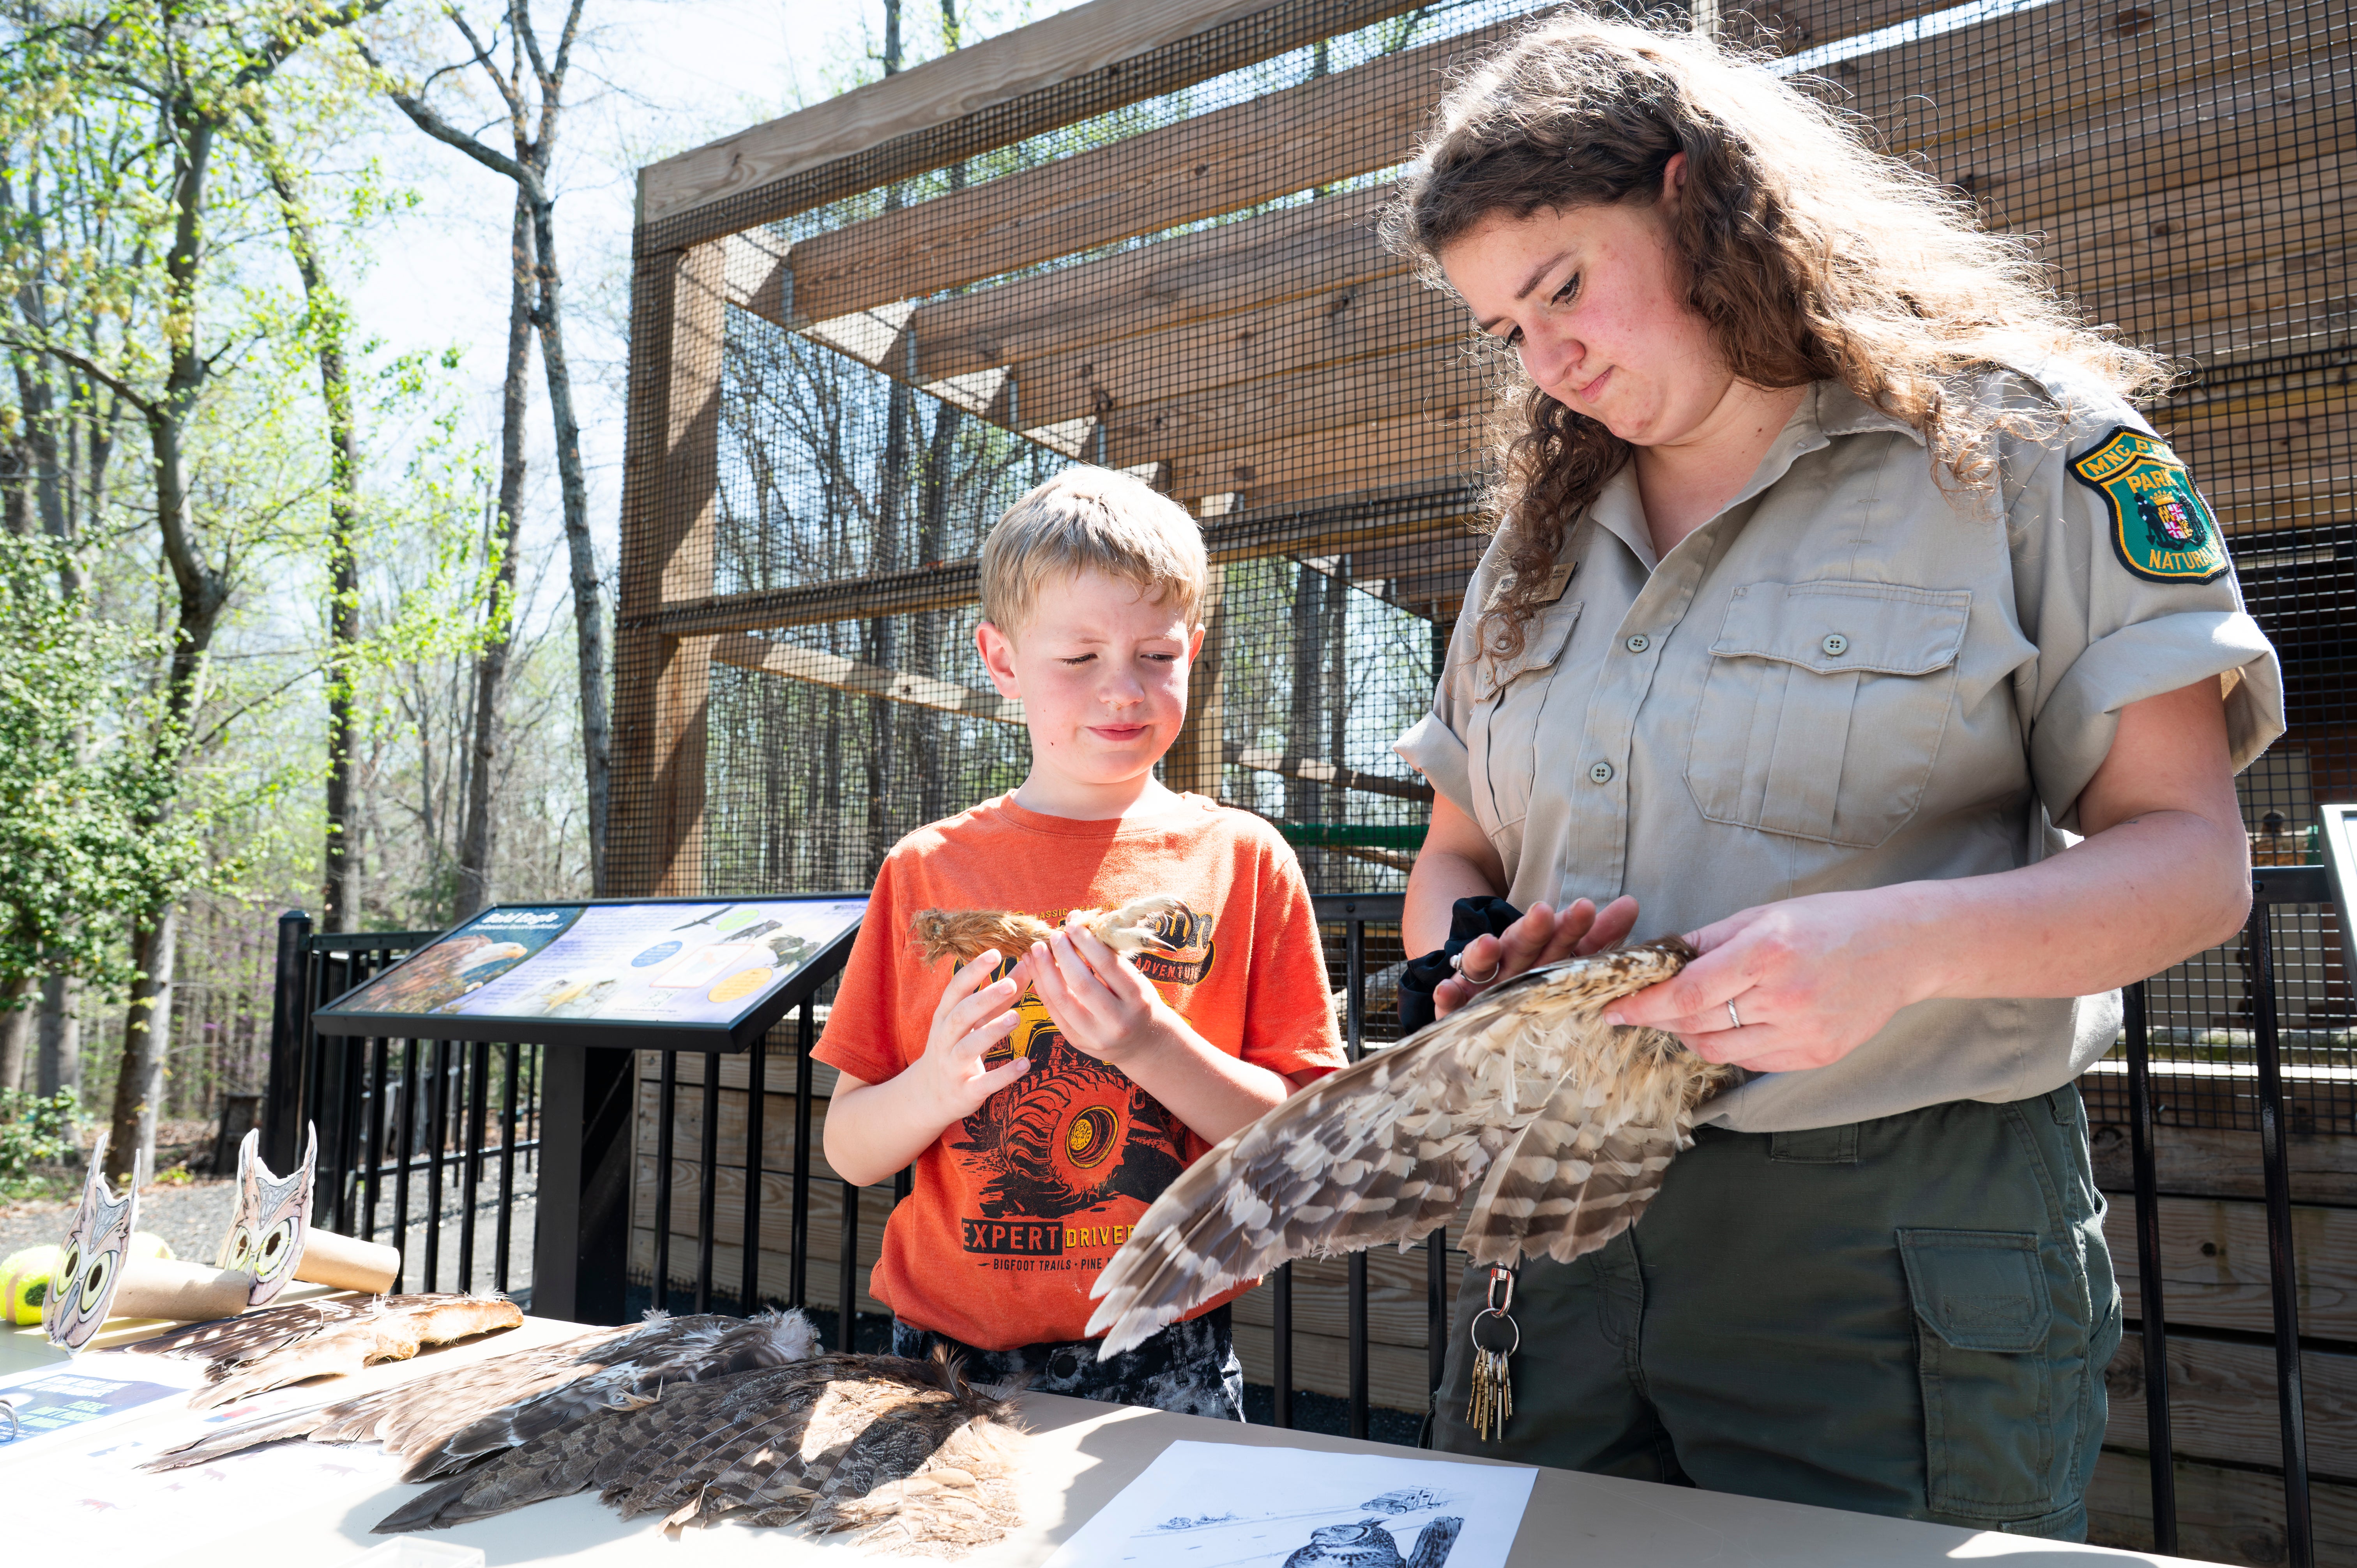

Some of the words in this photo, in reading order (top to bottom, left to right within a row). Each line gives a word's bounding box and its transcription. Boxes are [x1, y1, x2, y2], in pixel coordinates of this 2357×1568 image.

[2086, 444, 2131, 475] MNC
[2126, 468, 2179, 494] PARK
[963, 1222, 1059, 1250] EXPERT
[994, 1259, 1035, 1271] BIGFOOT
[1039, 1259, 1071, 1271] TRAILS
[1081, 1258, 1102, 1270] PINE
